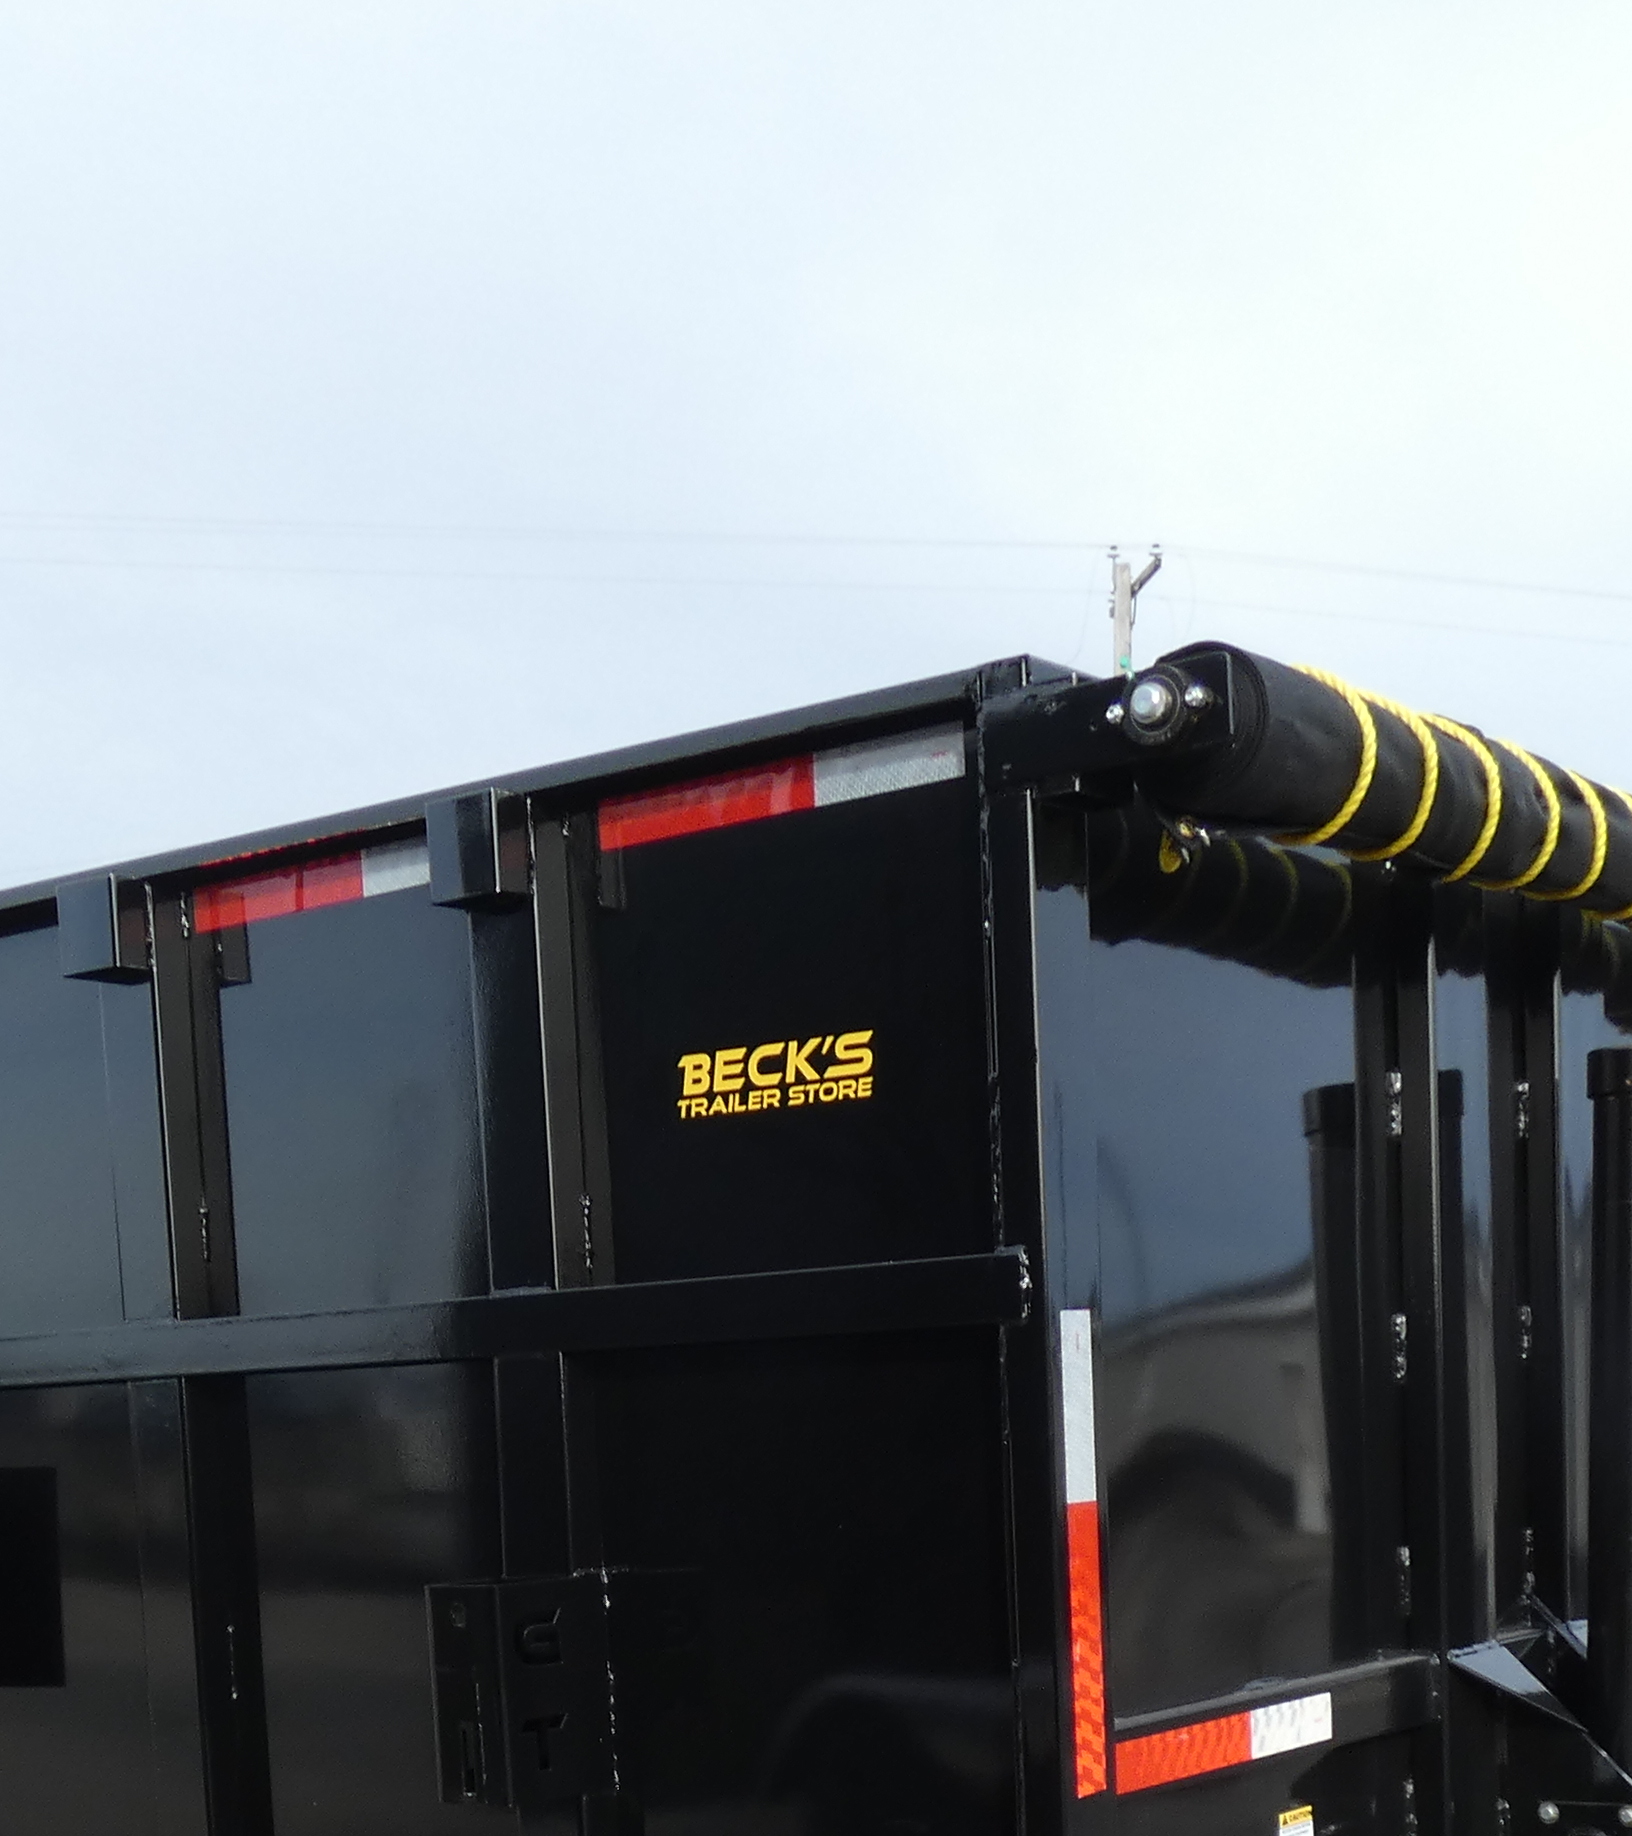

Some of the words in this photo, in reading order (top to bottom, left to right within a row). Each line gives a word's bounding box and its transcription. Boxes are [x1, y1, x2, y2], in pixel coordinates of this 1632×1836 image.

[677, 1029, 873, 1096] BECK'S
[677, 1090, 780, 1119] TRAILER
[787, 1076, 873, 1106] STORE
